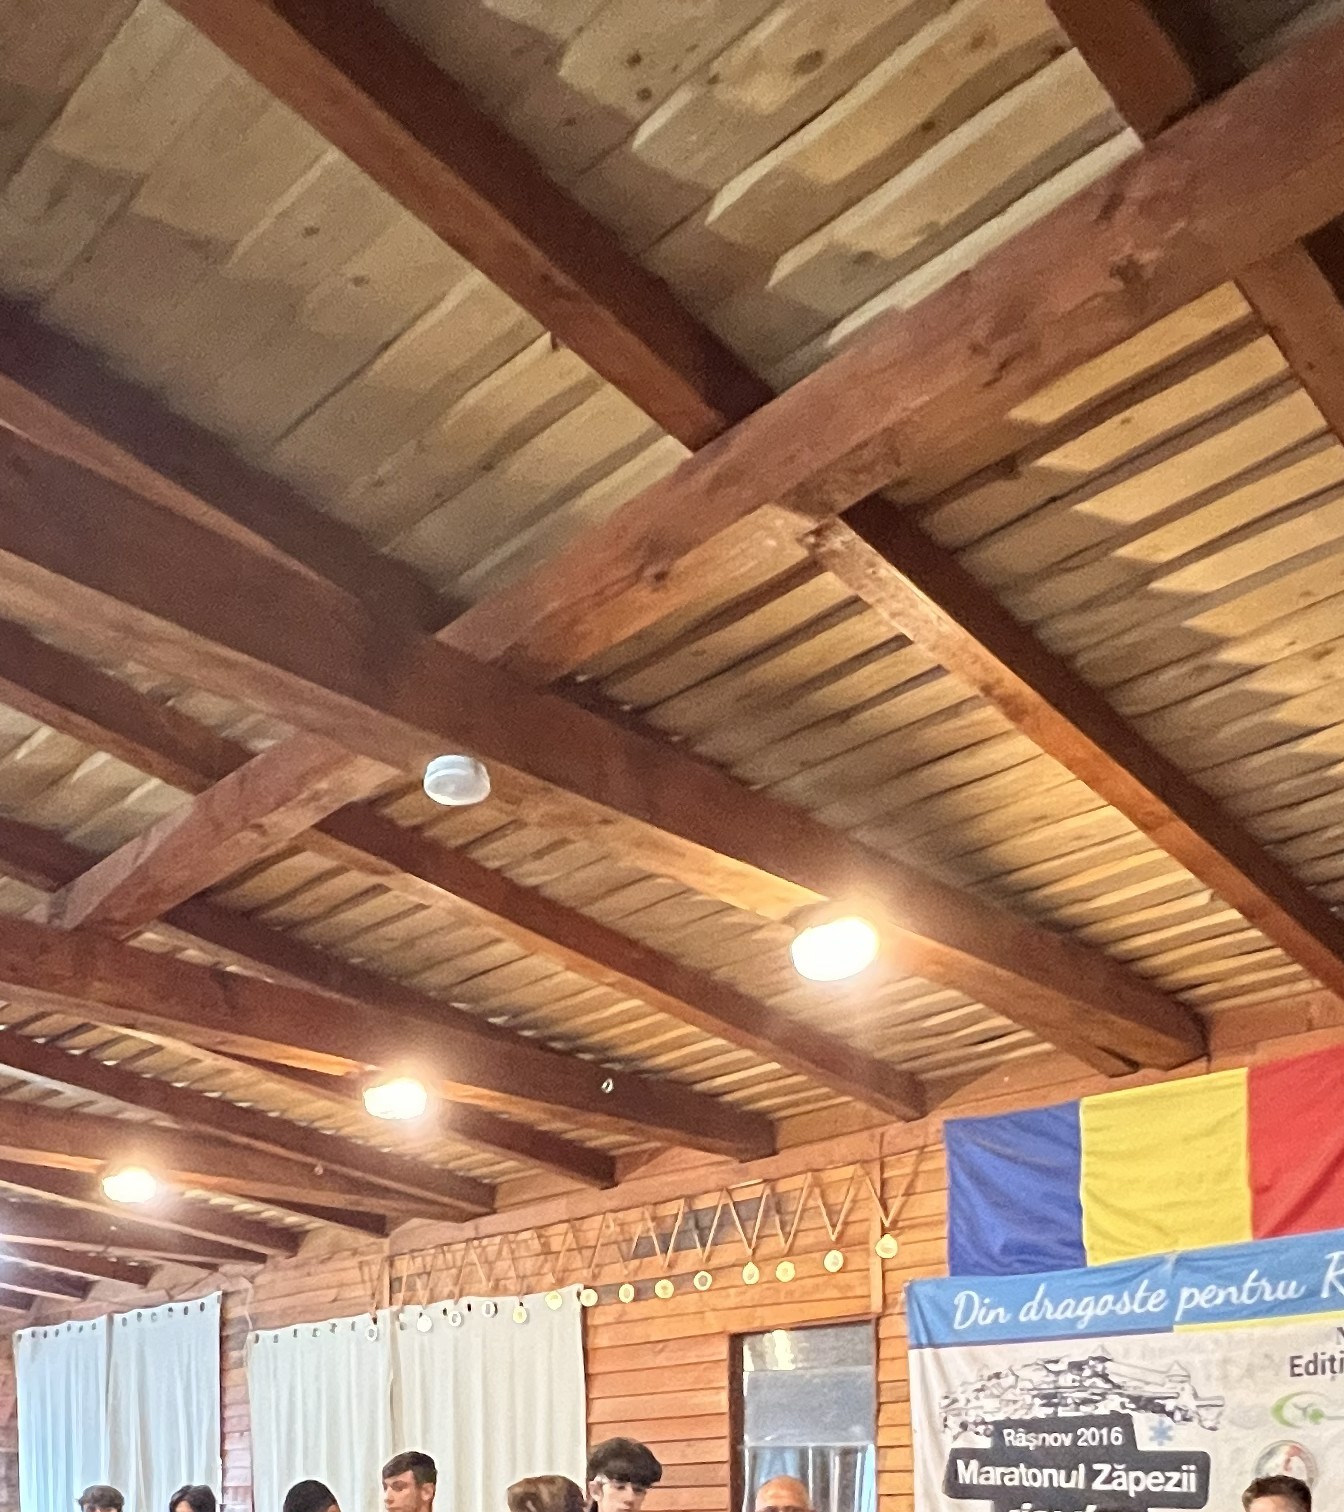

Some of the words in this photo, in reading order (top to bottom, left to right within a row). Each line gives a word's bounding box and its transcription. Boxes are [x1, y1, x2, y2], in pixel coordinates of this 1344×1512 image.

[953, 1290, 1012, 1330] Din
[1019, 1279, 1169, 1329] dragoste
[1174, 1268, 1306, 1322] pentru
[1076, 1427, 1123, 1446] 2016
[957, 1459, 1086, 1489] Maratonul
[1092, 1463, 1198, 1497] Zăpezii
